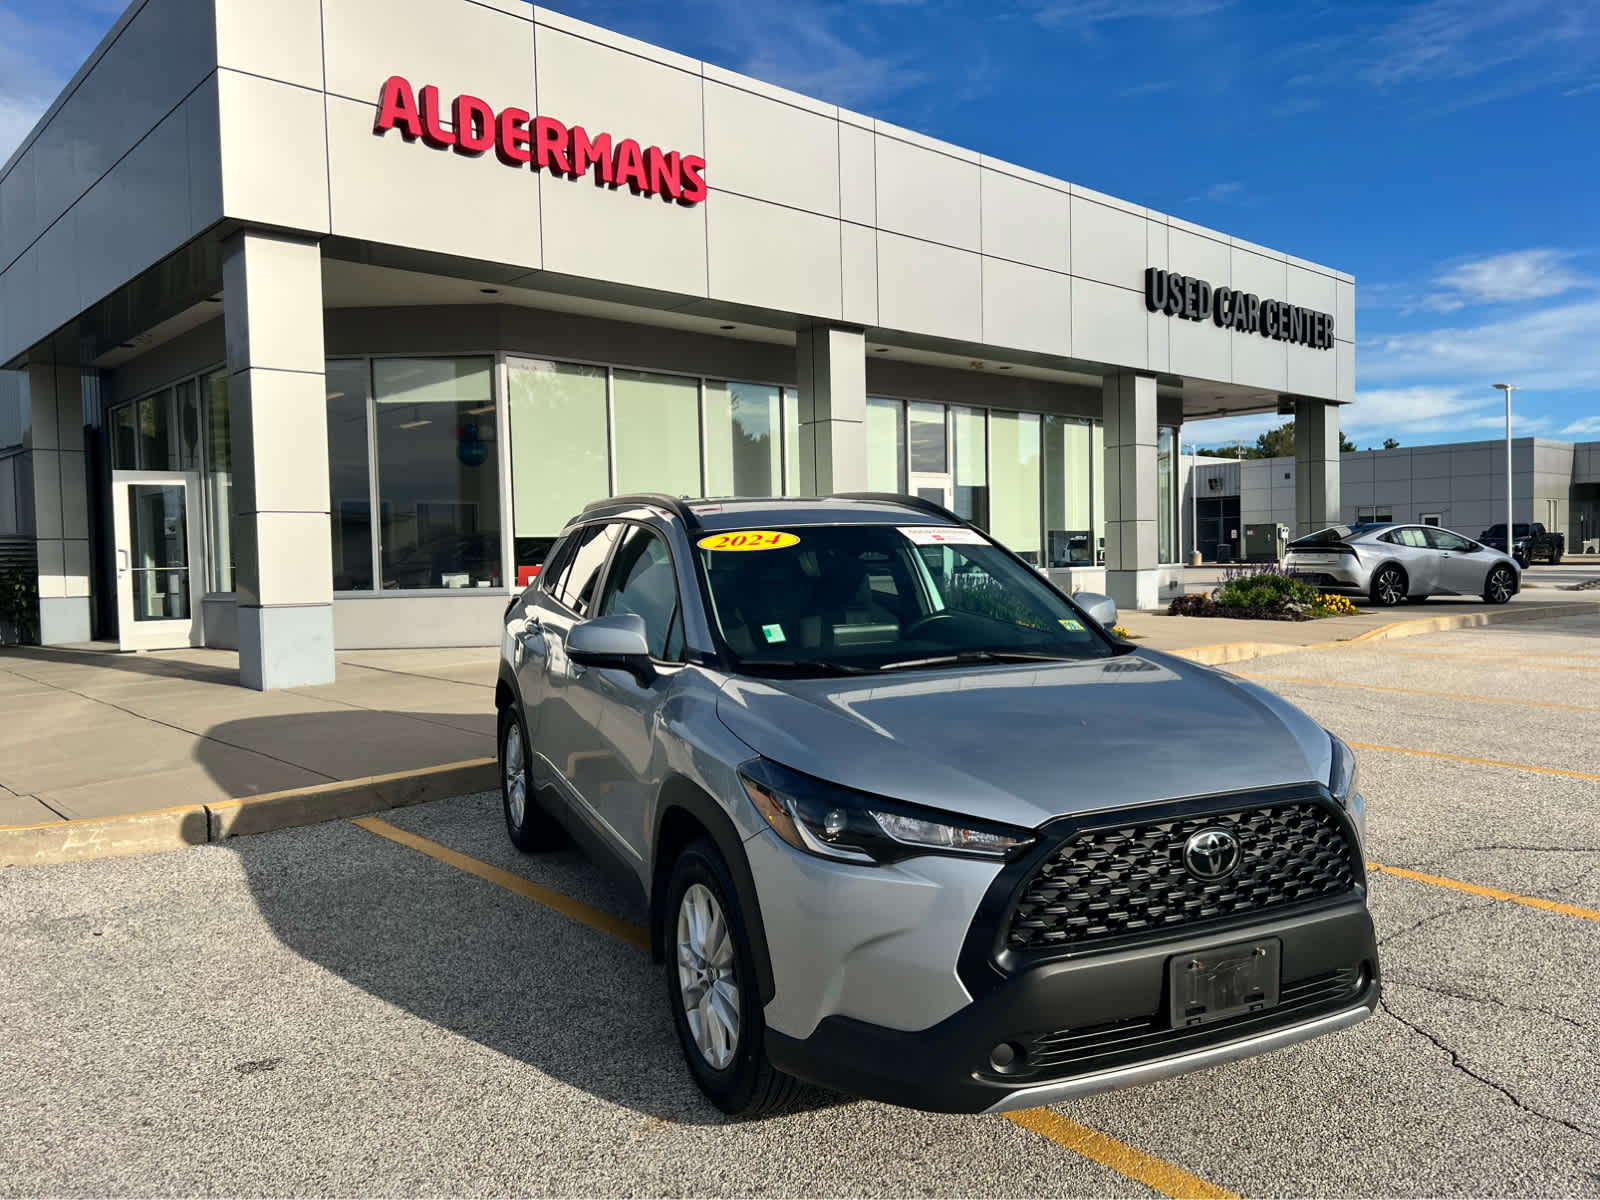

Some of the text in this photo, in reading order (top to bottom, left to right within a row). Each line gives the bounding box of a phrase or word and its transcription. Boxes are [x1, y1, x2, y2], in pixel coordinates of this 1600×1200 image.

[374, 75, 707, 206] ALDERMANS
[1145, 267, 1335, 350] USED CAR CENTER
[714, 533, 782, 548] 2024
